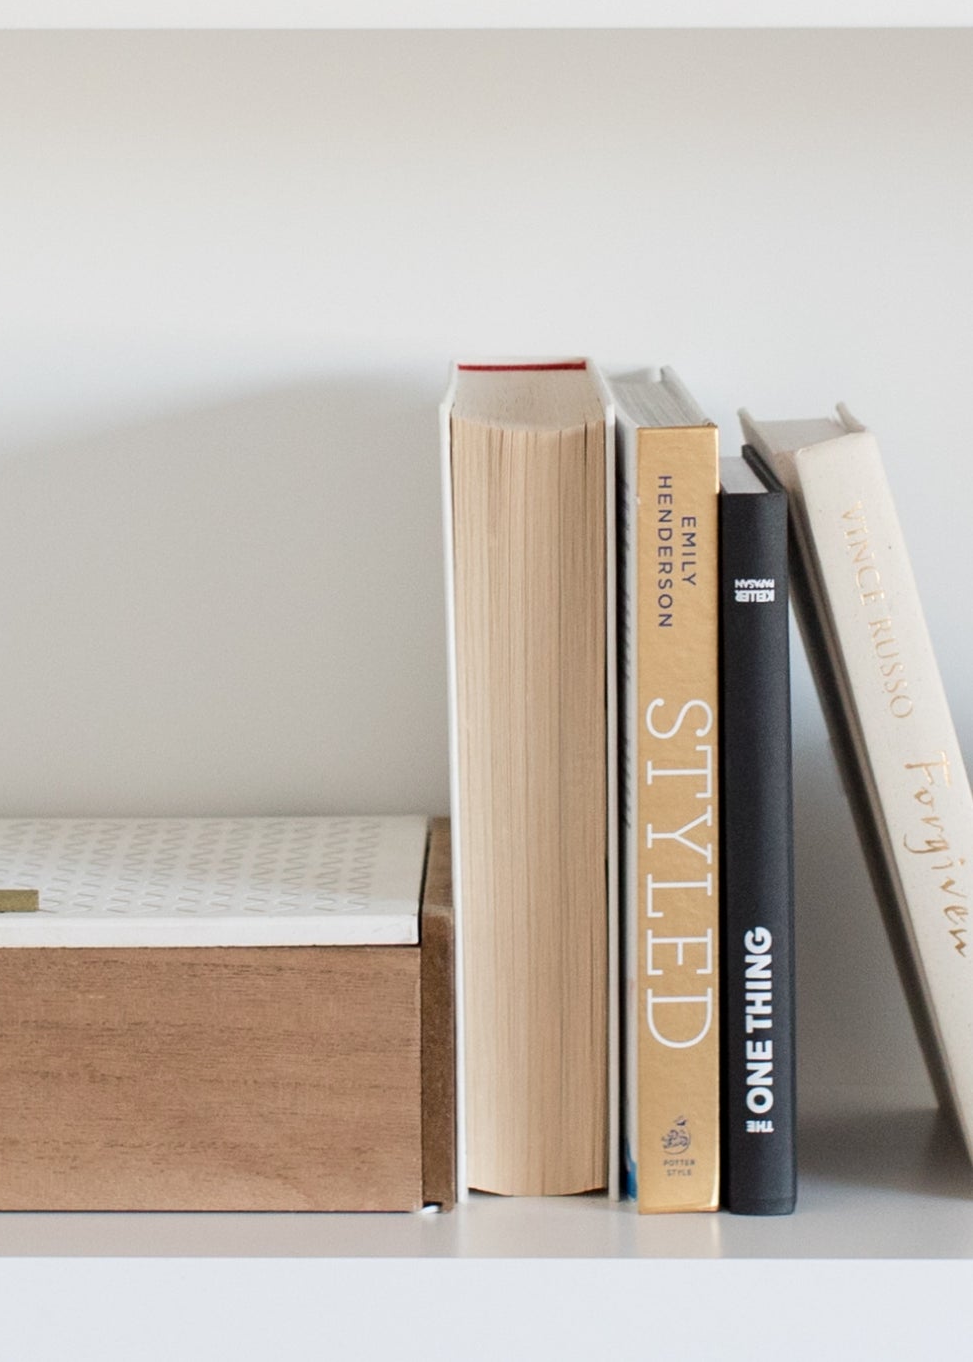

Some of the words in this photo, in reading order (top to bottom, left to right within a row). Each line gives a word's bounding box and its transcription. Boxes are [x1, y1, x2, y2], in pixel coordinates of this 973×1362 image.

[657, 475, 674, 628] HENDERSON
[681, 516, 697, 586] EMILY
[840, 500, 886, 607] VINCE
[867, 615, 914, 720] RUSSO
[645, 697, 714, 1050] STYLED
[903, 749, 970, 958] Forgiven
[743, 926, 773, 1034] THING
[745, 1040, 775, 1114] ONE
[745, 1119, 775, 1133] THE
